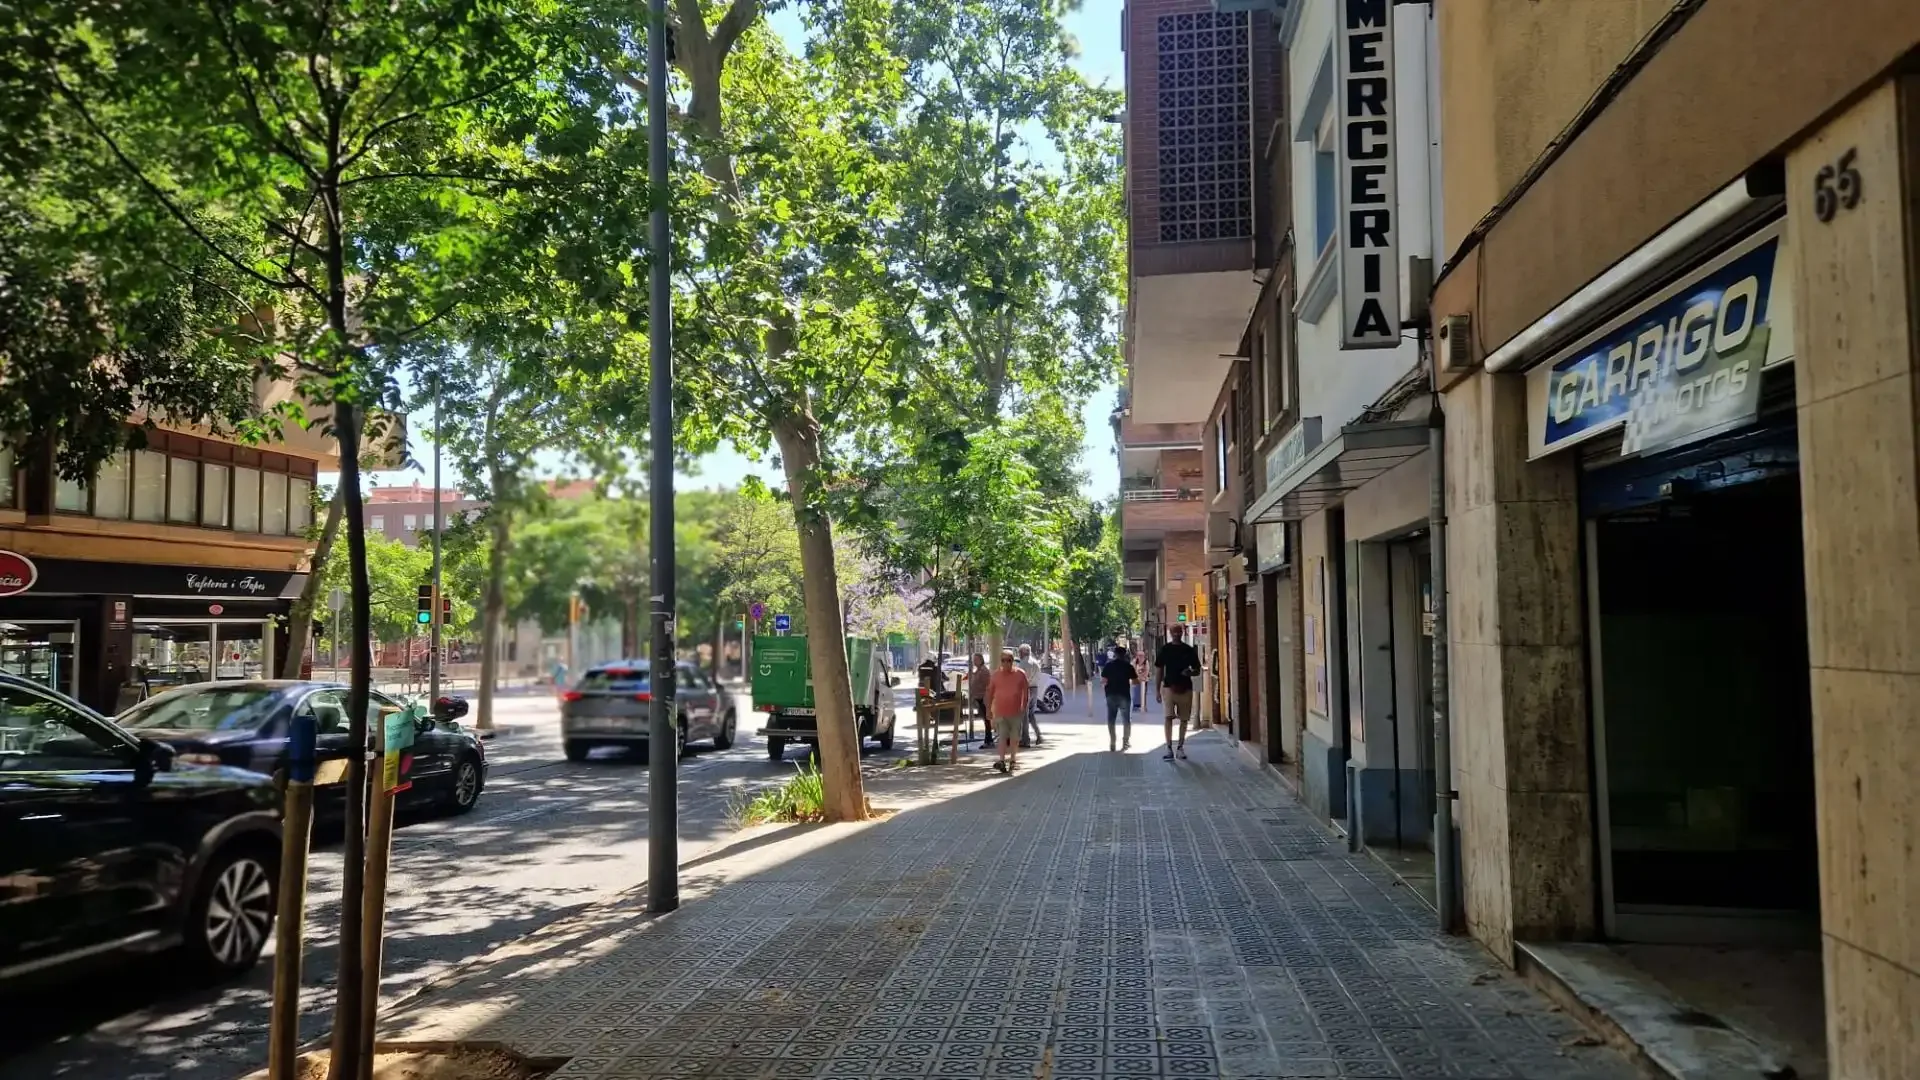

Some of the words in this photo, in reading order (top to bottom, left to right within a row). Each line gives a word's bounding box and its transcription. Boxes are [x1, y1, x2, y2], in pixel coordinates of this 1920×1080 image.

[1346, 0, 1392, 338] MERCERIA
[1814, 146, 1862, 223] 65
[1554, 275, 1758, 425] GARRIGO
[1654, 359, 1750, 424] MOTOS
[186, 573, 228, 593] Cafeteria
[230, 579, 237, 589] i
[239, 576, 266, 594] Tapes
